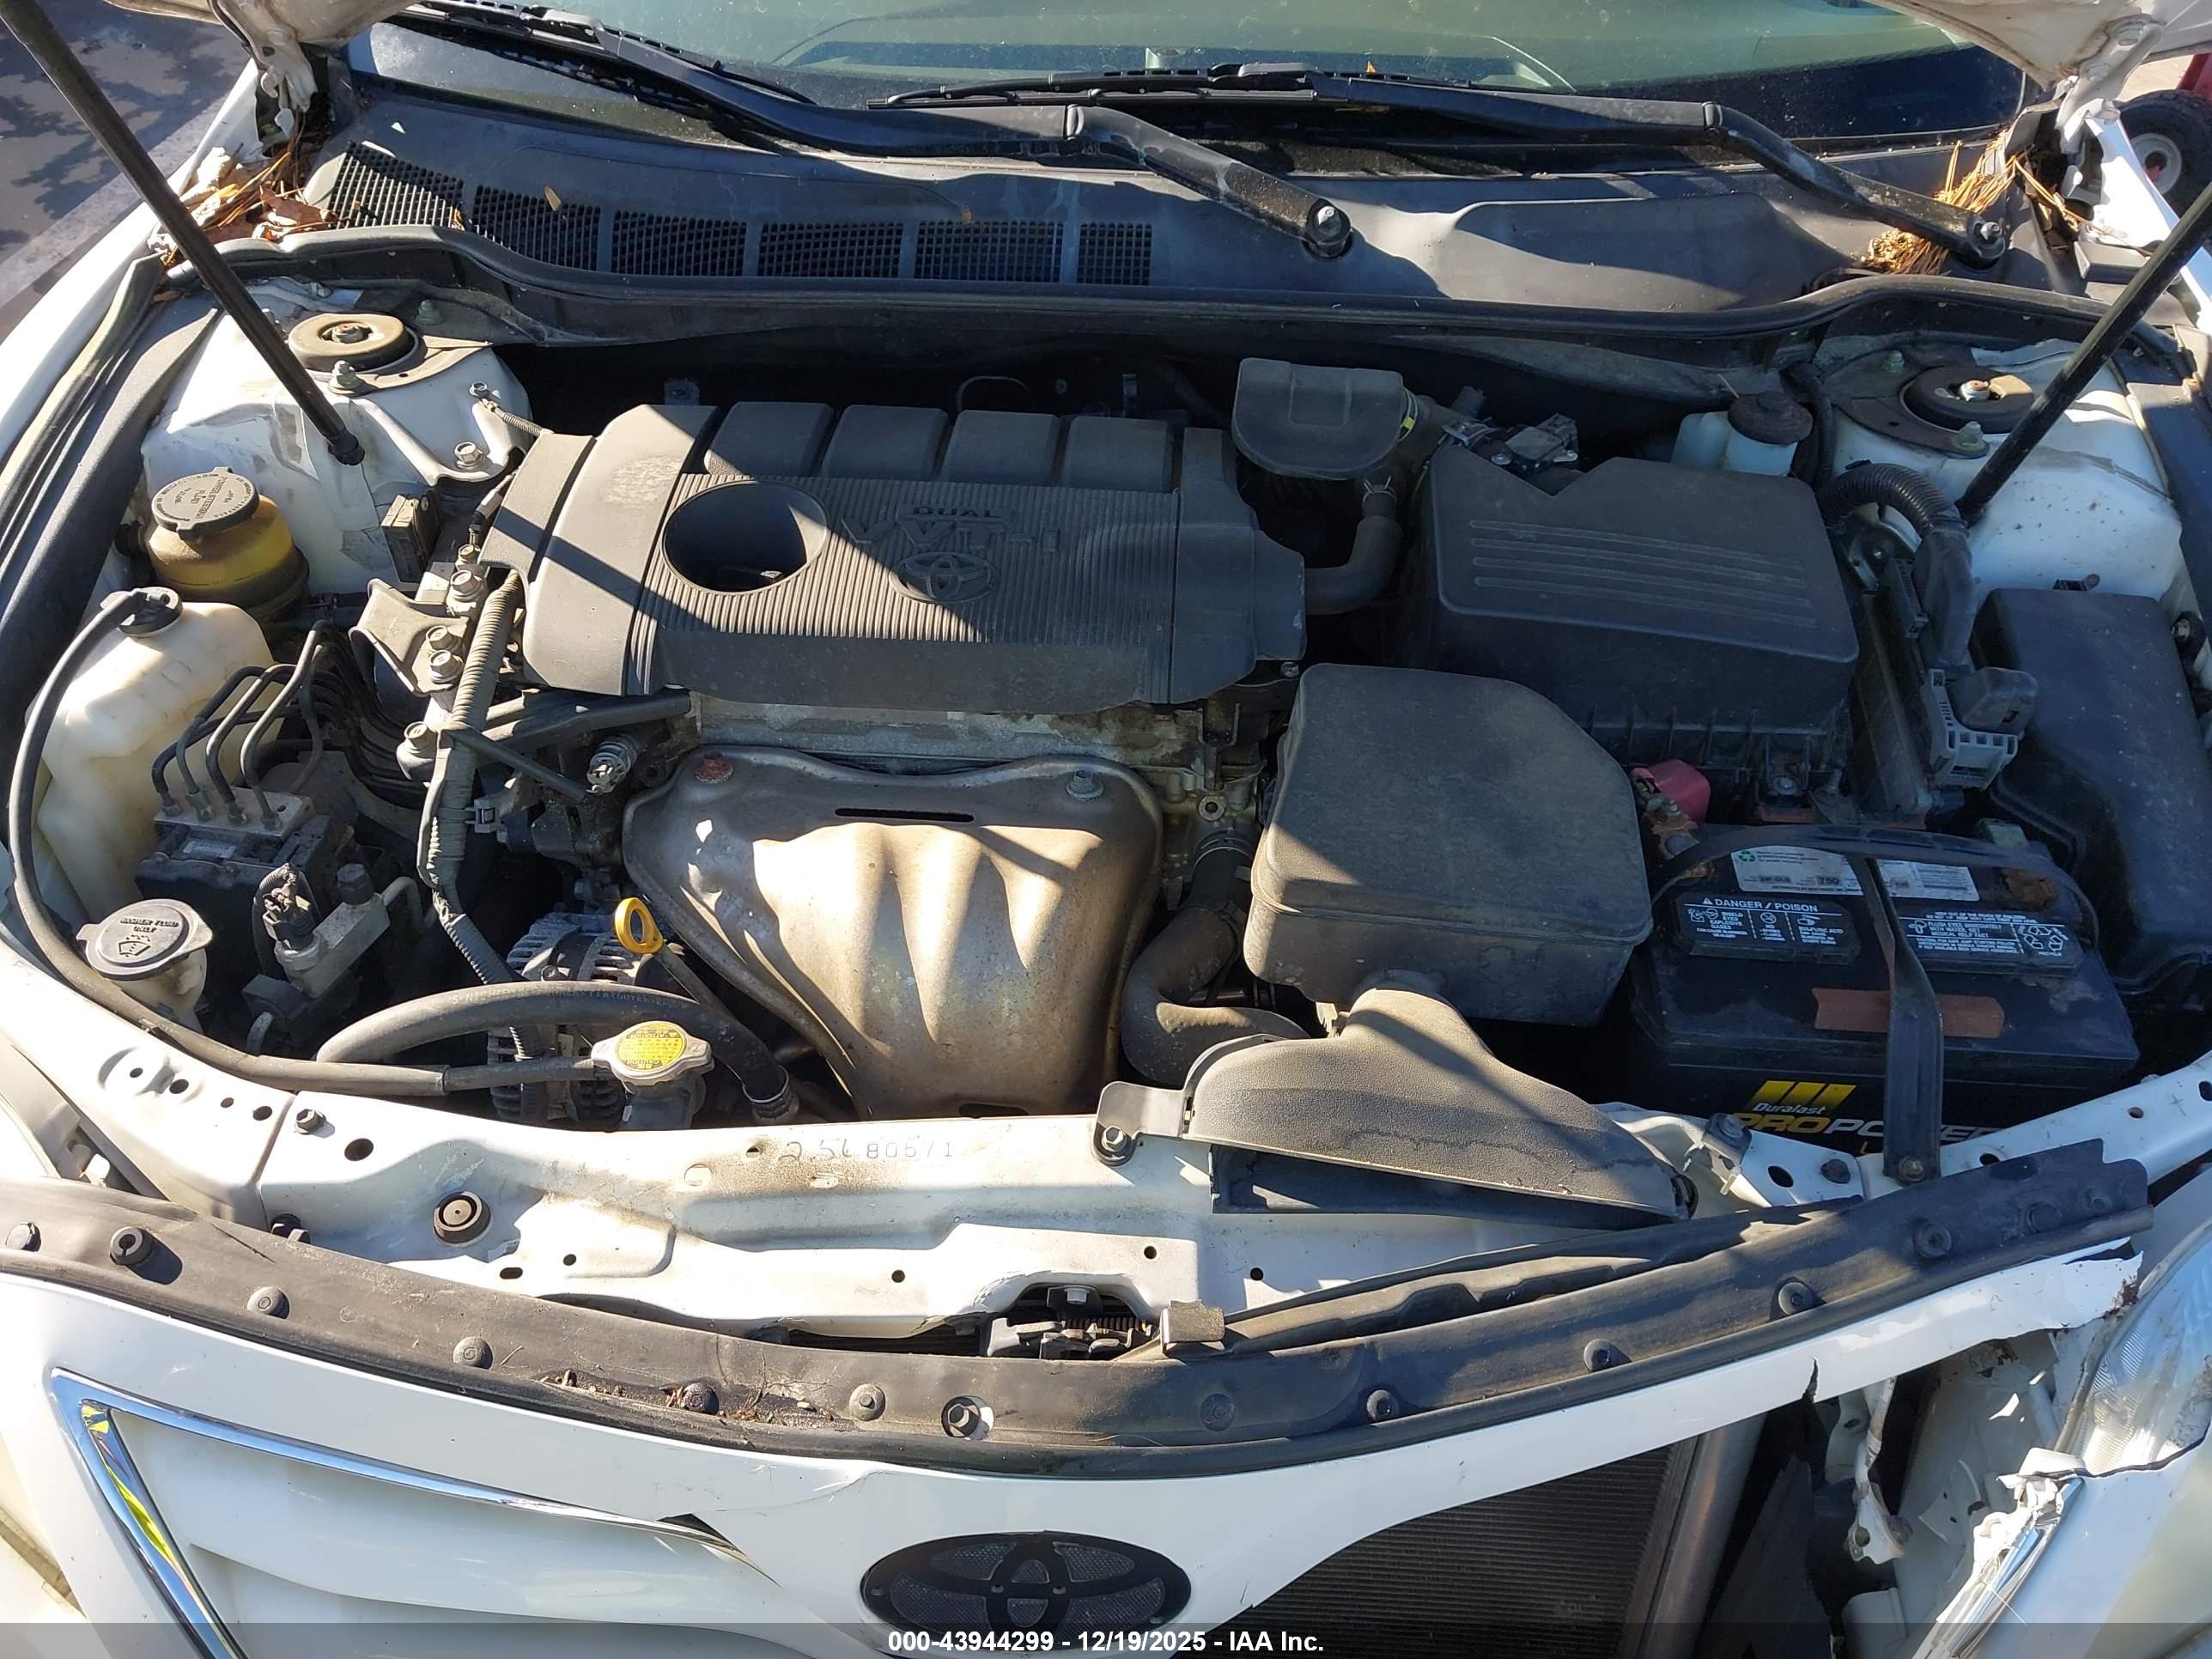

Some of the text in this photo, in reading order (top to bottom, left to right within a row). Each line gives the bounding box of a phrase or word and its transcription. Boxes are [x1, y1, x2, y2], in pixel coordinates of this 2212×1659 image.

[1715, 898, 1762, 909] DANGER
[1775, 903, 1819, 913] POISON
[1753, 1103, 1828, 1115] Duralast
